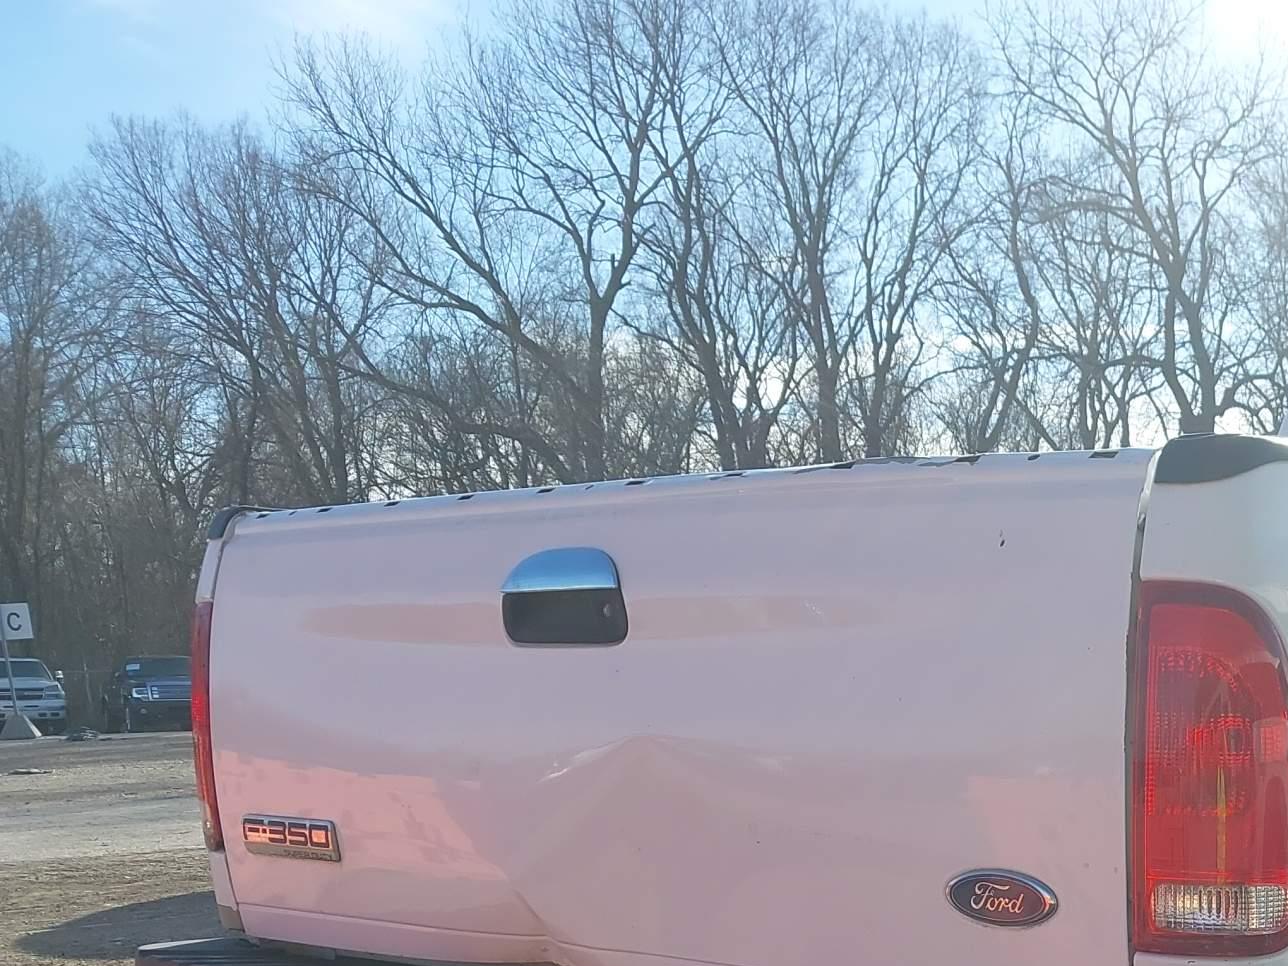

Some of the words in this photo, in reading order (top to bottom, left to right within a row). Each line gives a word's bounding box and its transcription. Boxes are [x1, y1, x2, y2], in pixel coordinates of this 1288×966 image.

[7, 612, 22, 631] C
[243, 818, 330, 849] F-350
[970, 881, 1024, 913] Ford
